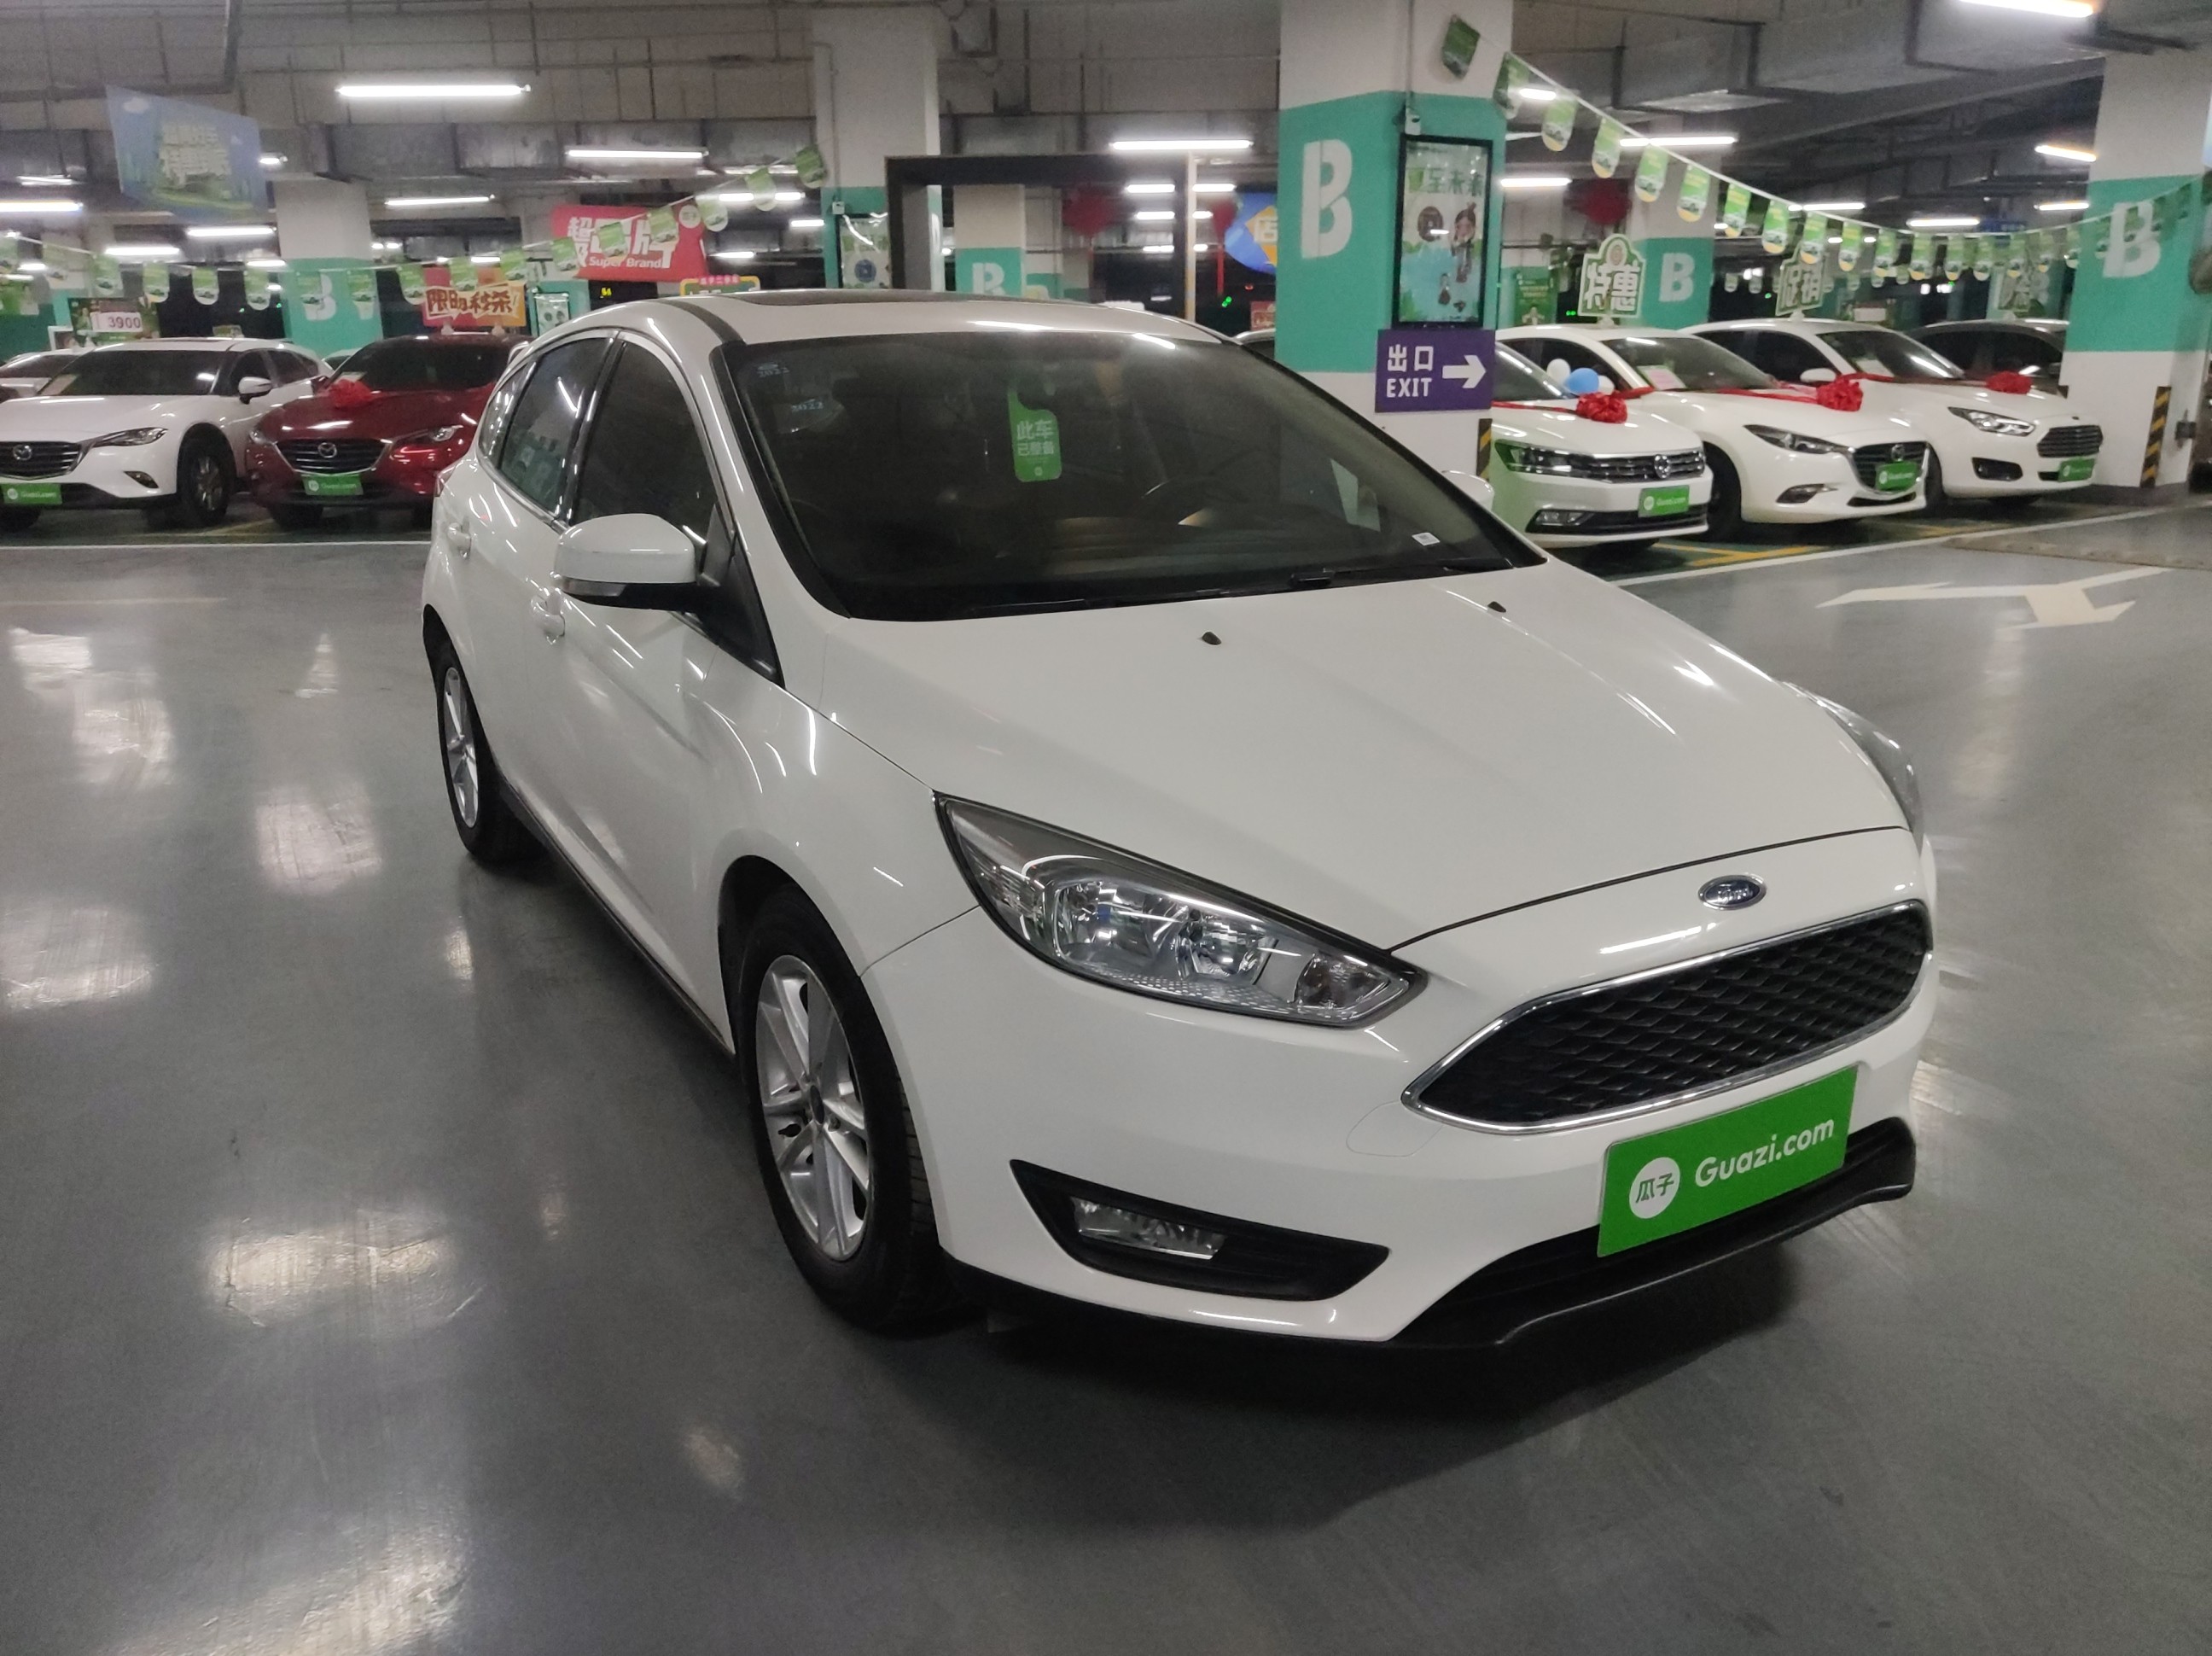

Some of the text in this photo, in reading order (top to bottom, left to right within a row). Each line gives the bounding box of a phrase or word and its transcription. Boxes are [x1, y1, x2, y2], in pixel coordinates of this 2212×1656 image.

[1301, 139, 1353, 259] B
[2103, 201, 2161, 277] B
[626, 257, 662, 267] Brand
[1658, 253, 1696, 301] B
[1584, 259, 1640, 312] 特惠
[108, 317, 141, 329] 3900
[1387, 344, 1434, 372] 出口
[1387, 377, 1432, 398] EXIT
[1016, 420, 1055, 440] 此车
[1635, 1119, 1834, 1204] 瓜子 Guazi.com
